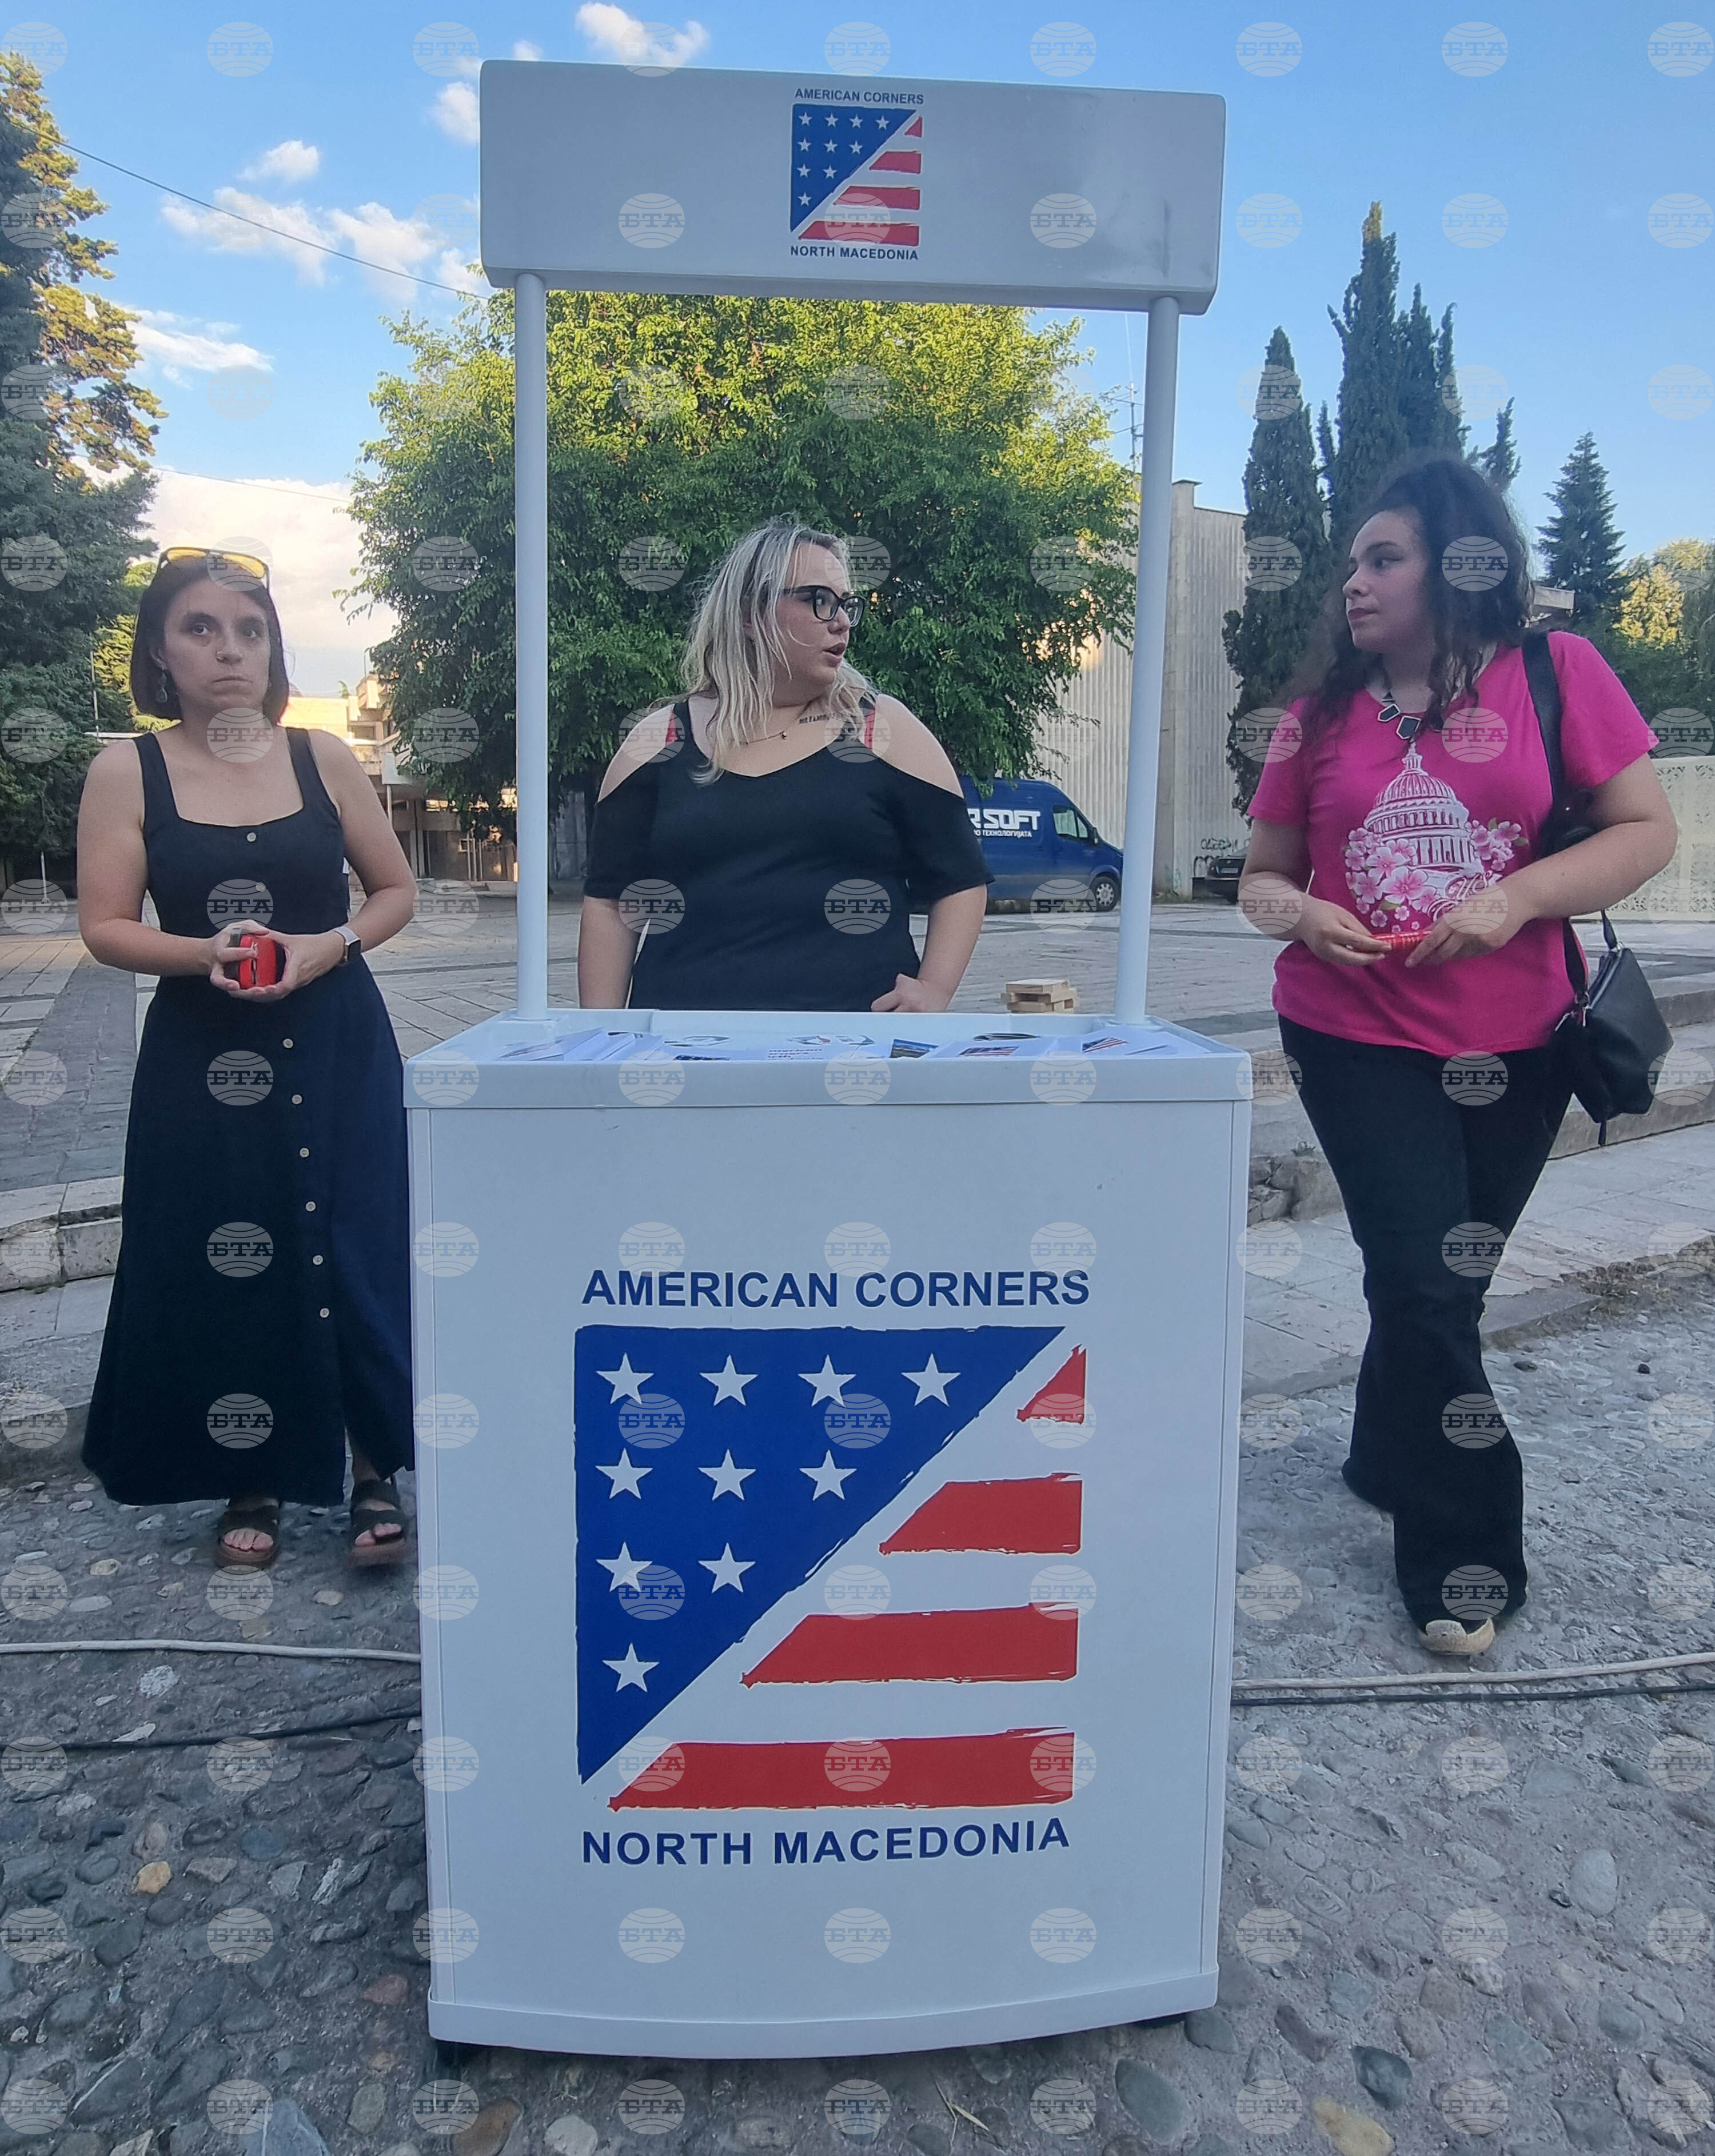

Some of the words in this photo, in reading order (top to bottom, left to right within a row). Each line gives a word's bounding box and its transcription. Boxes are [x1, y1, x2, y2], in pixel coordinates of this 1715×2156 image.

[795, 88, 860, 101] AMERICAN
[864, 91, 924, 105] CORNERS
[791, 245, 835, 257] NORTH
[840, 247, 918, 260] MACEDONIA
[581, 1269, 837, 1308] AMERICAN
[855, 1269, 1090, 1308] CORNERS
[583, 1831, 751, 1865] NORTH
[774, 1817, 1070, 1864] MACEDONIA
